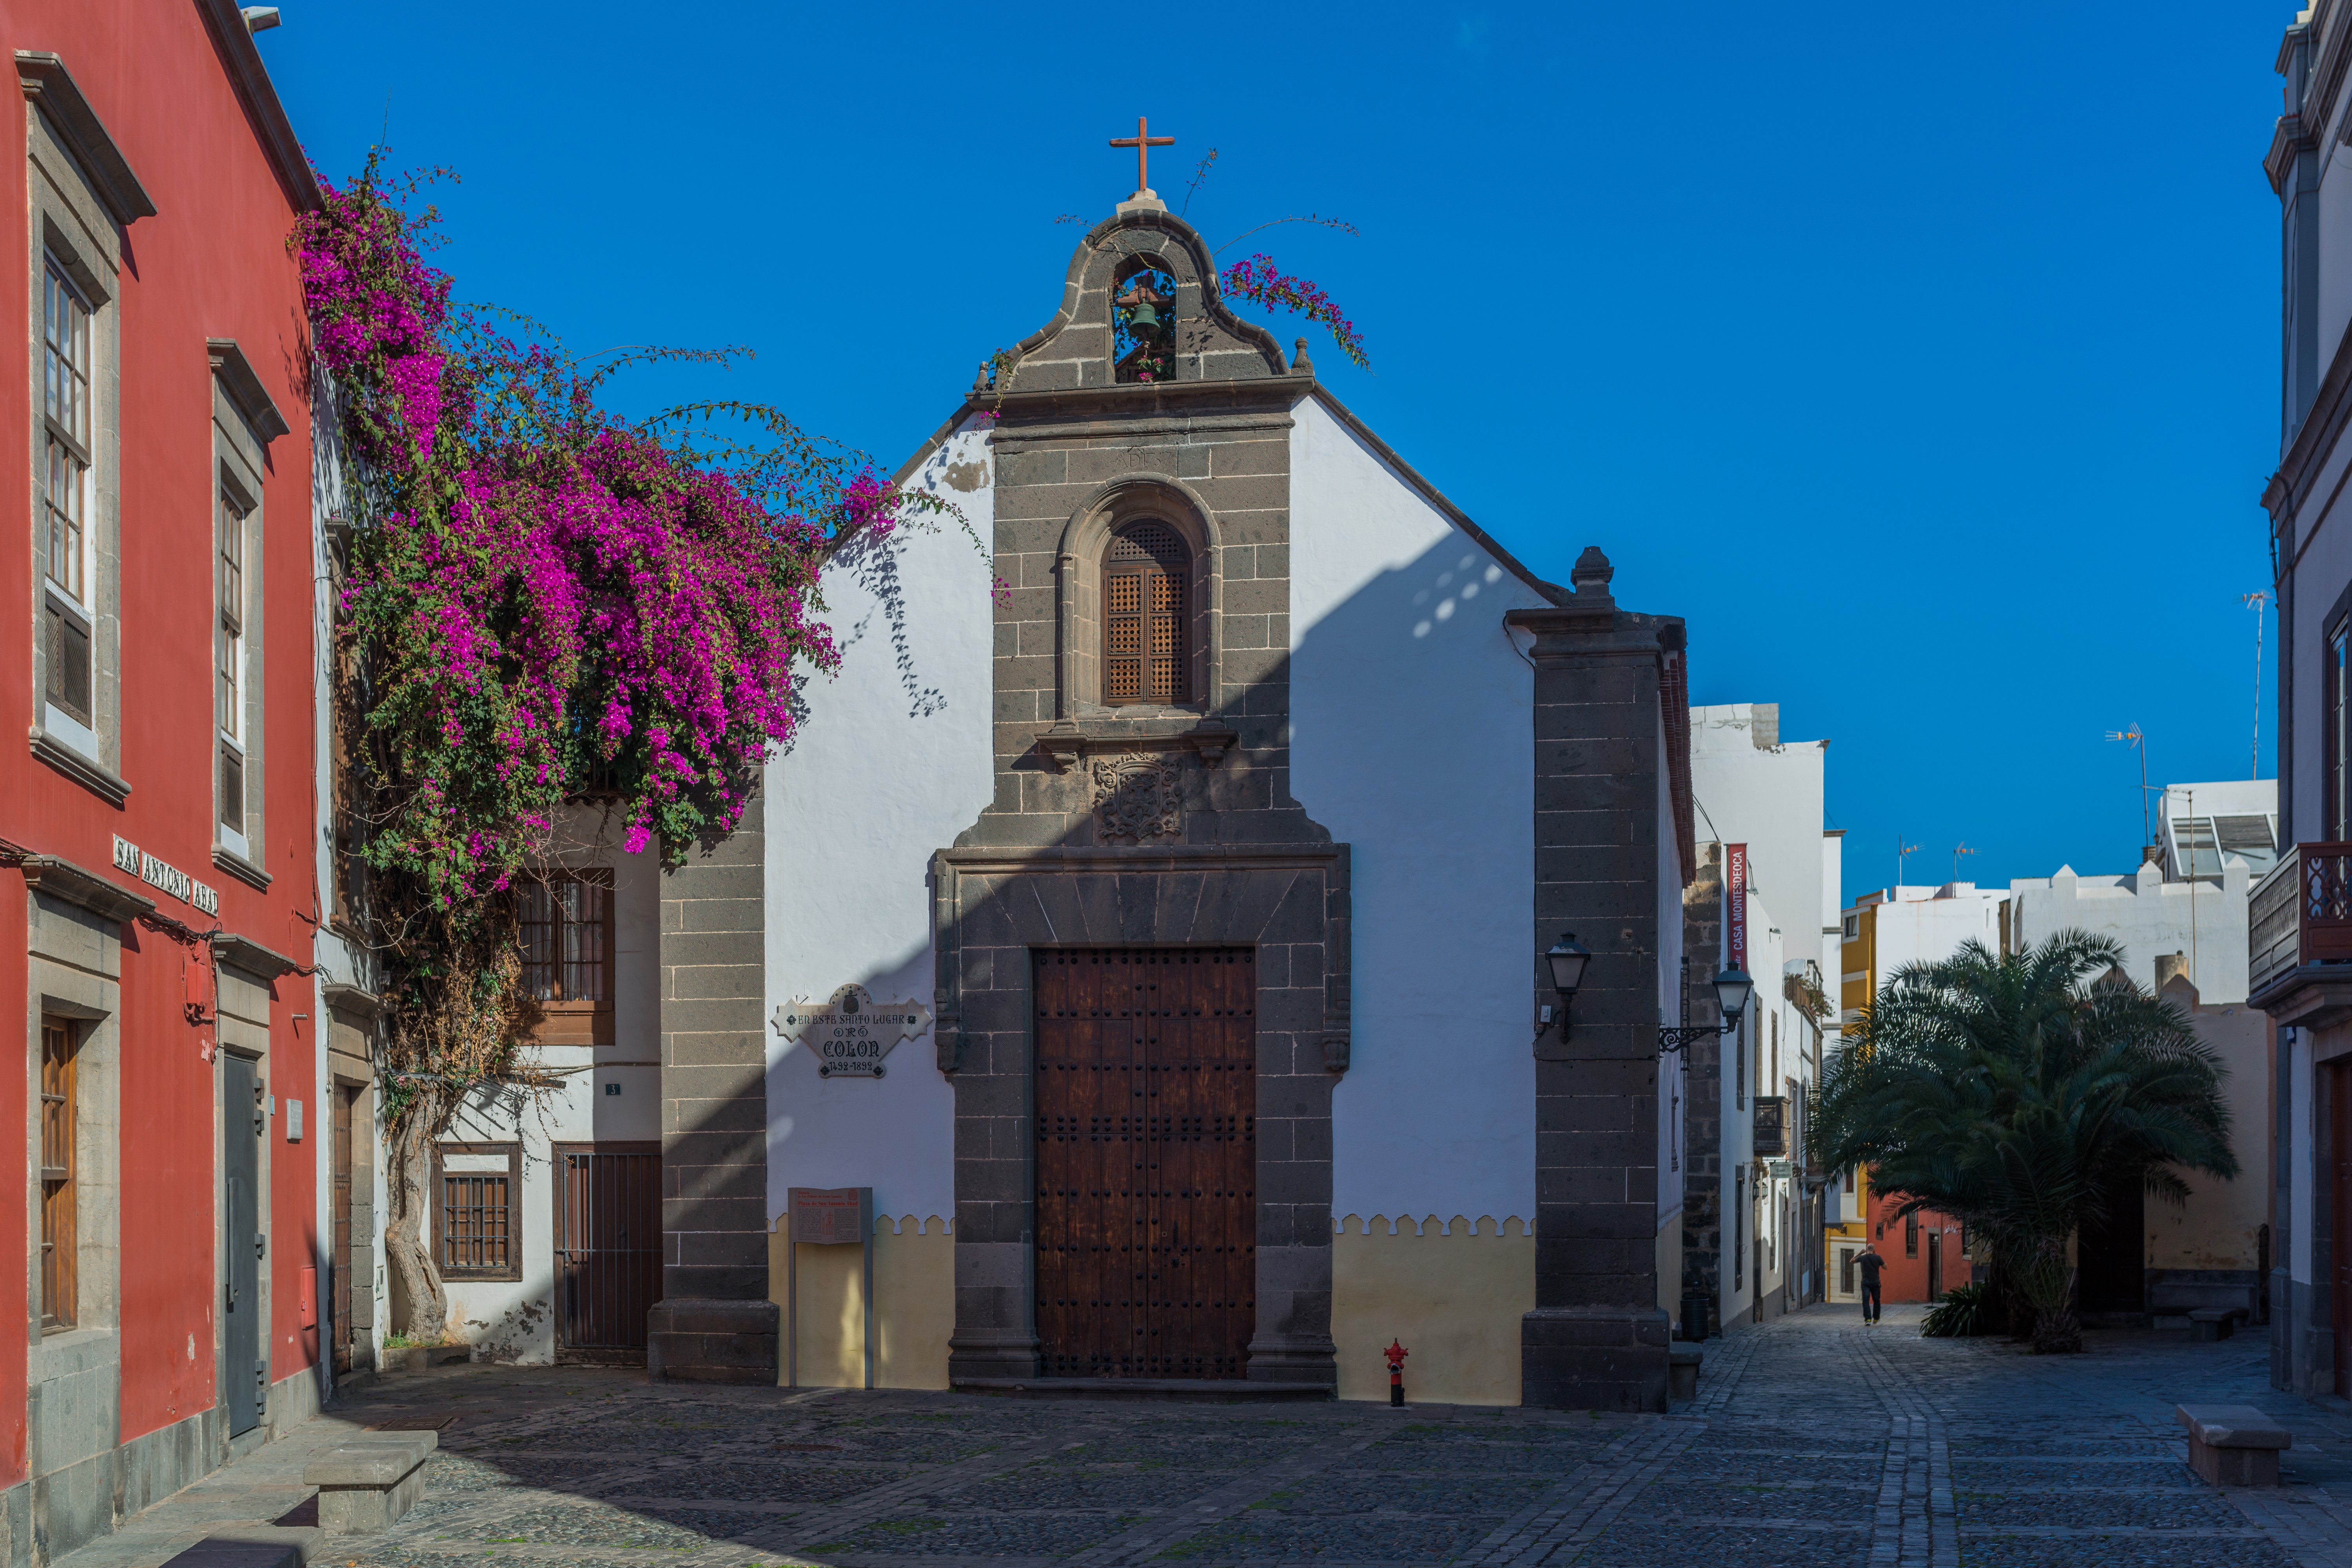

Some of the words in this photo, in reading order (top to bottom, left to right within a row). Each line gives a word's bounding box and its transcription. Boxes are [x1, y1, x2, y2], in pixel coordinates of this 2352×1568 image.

[118, 840, 140, 874] SAN
[144, 854, 191, 901] ANTONIO
[195, 883, 218, 915] ABAD
[1733, 851, 1742, 922] MONTESDEOCA
[1733, 925, 1742, 950] CASA
[798, 1015, 810, 1024] EN
[813, 1014, 837, 1024] ESTE
[839, 1014, 870, 1024] SANTO
[873, 1014, 904, 1024] LUGAR
[823, 1040, 879, 1057] COLON
[829, 1062, 873, 1071] 1492-1892
[611, 1085, 615, 1094] 3
